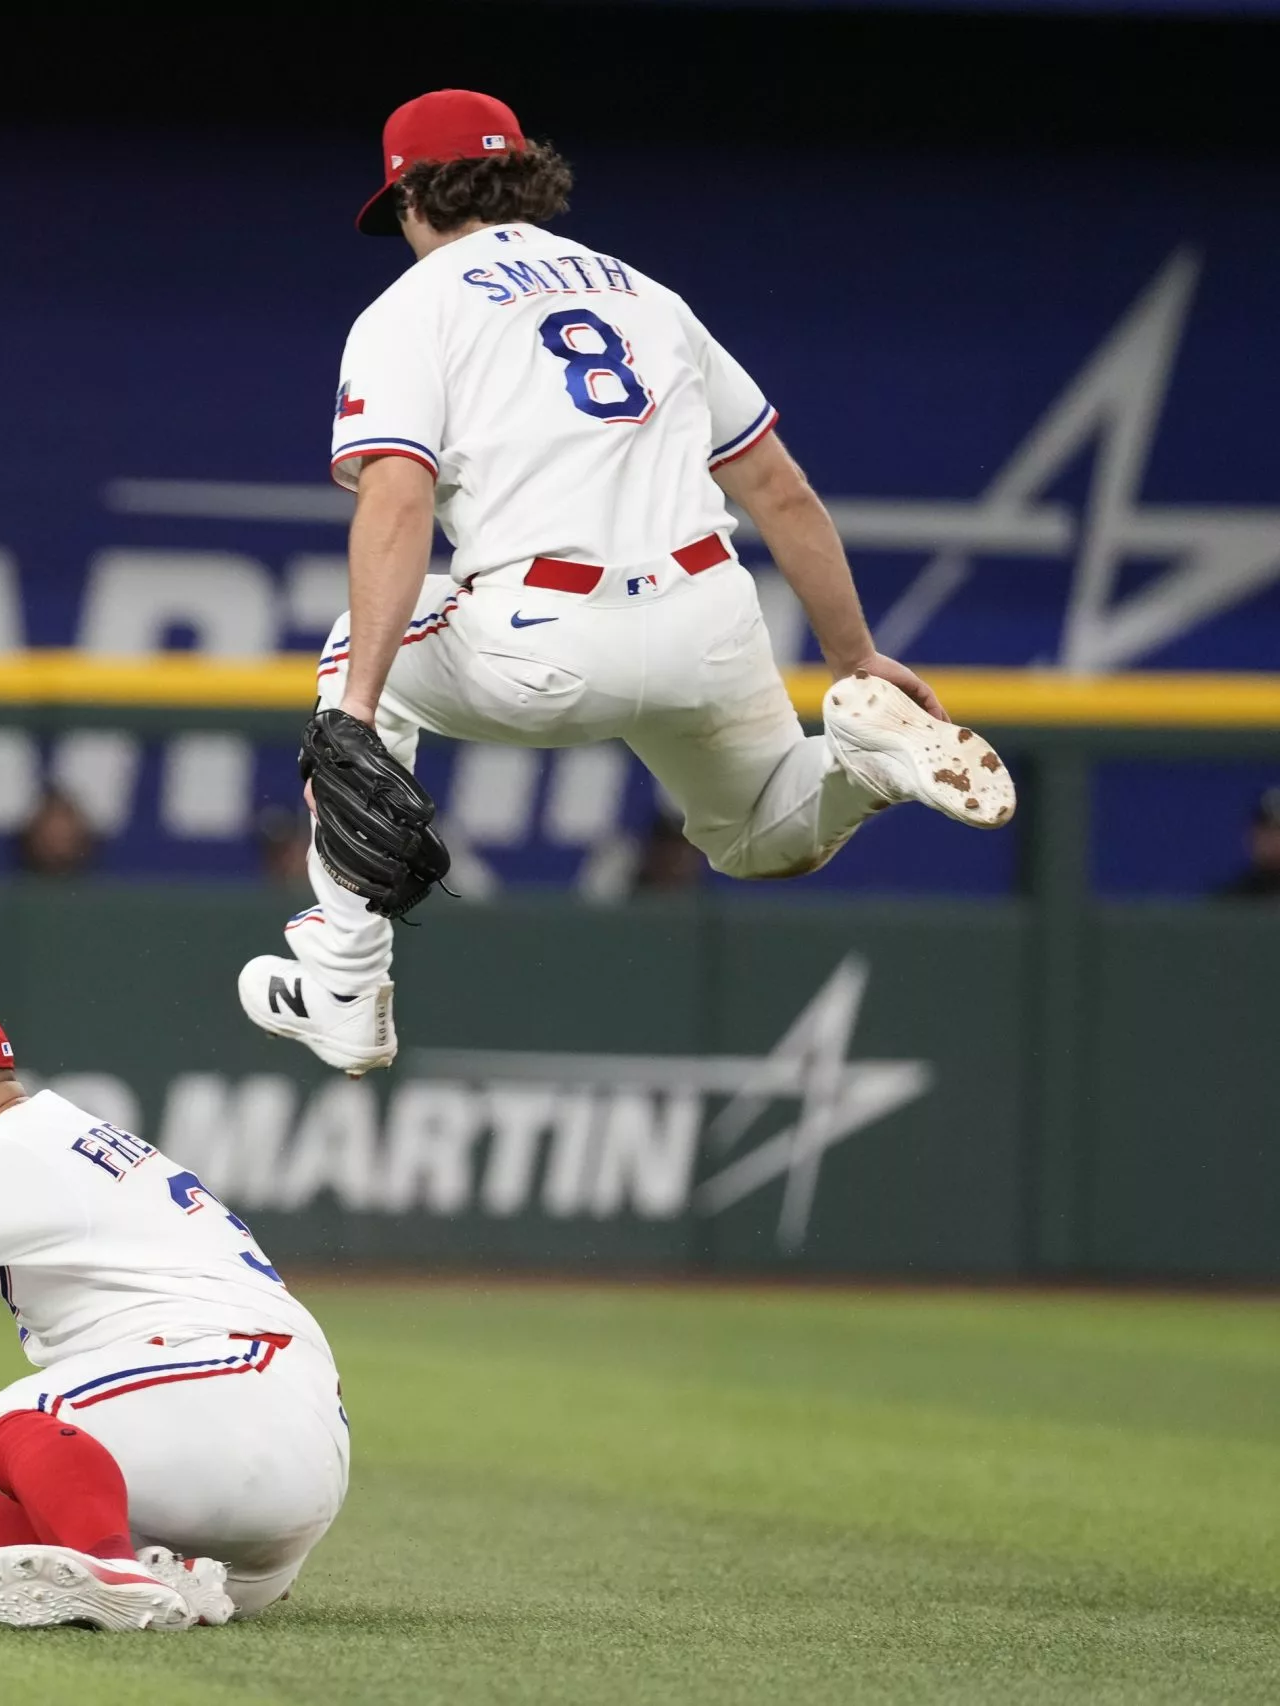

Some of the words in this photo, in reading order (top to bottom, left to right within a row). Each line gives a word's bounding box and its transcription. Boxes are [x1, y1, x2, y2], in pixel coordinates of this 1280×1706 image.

[463, 256, 639, 306] SMITH
[538, 308, 657, 425] 8
[158, 1073, 704, 1220] MARTIN
